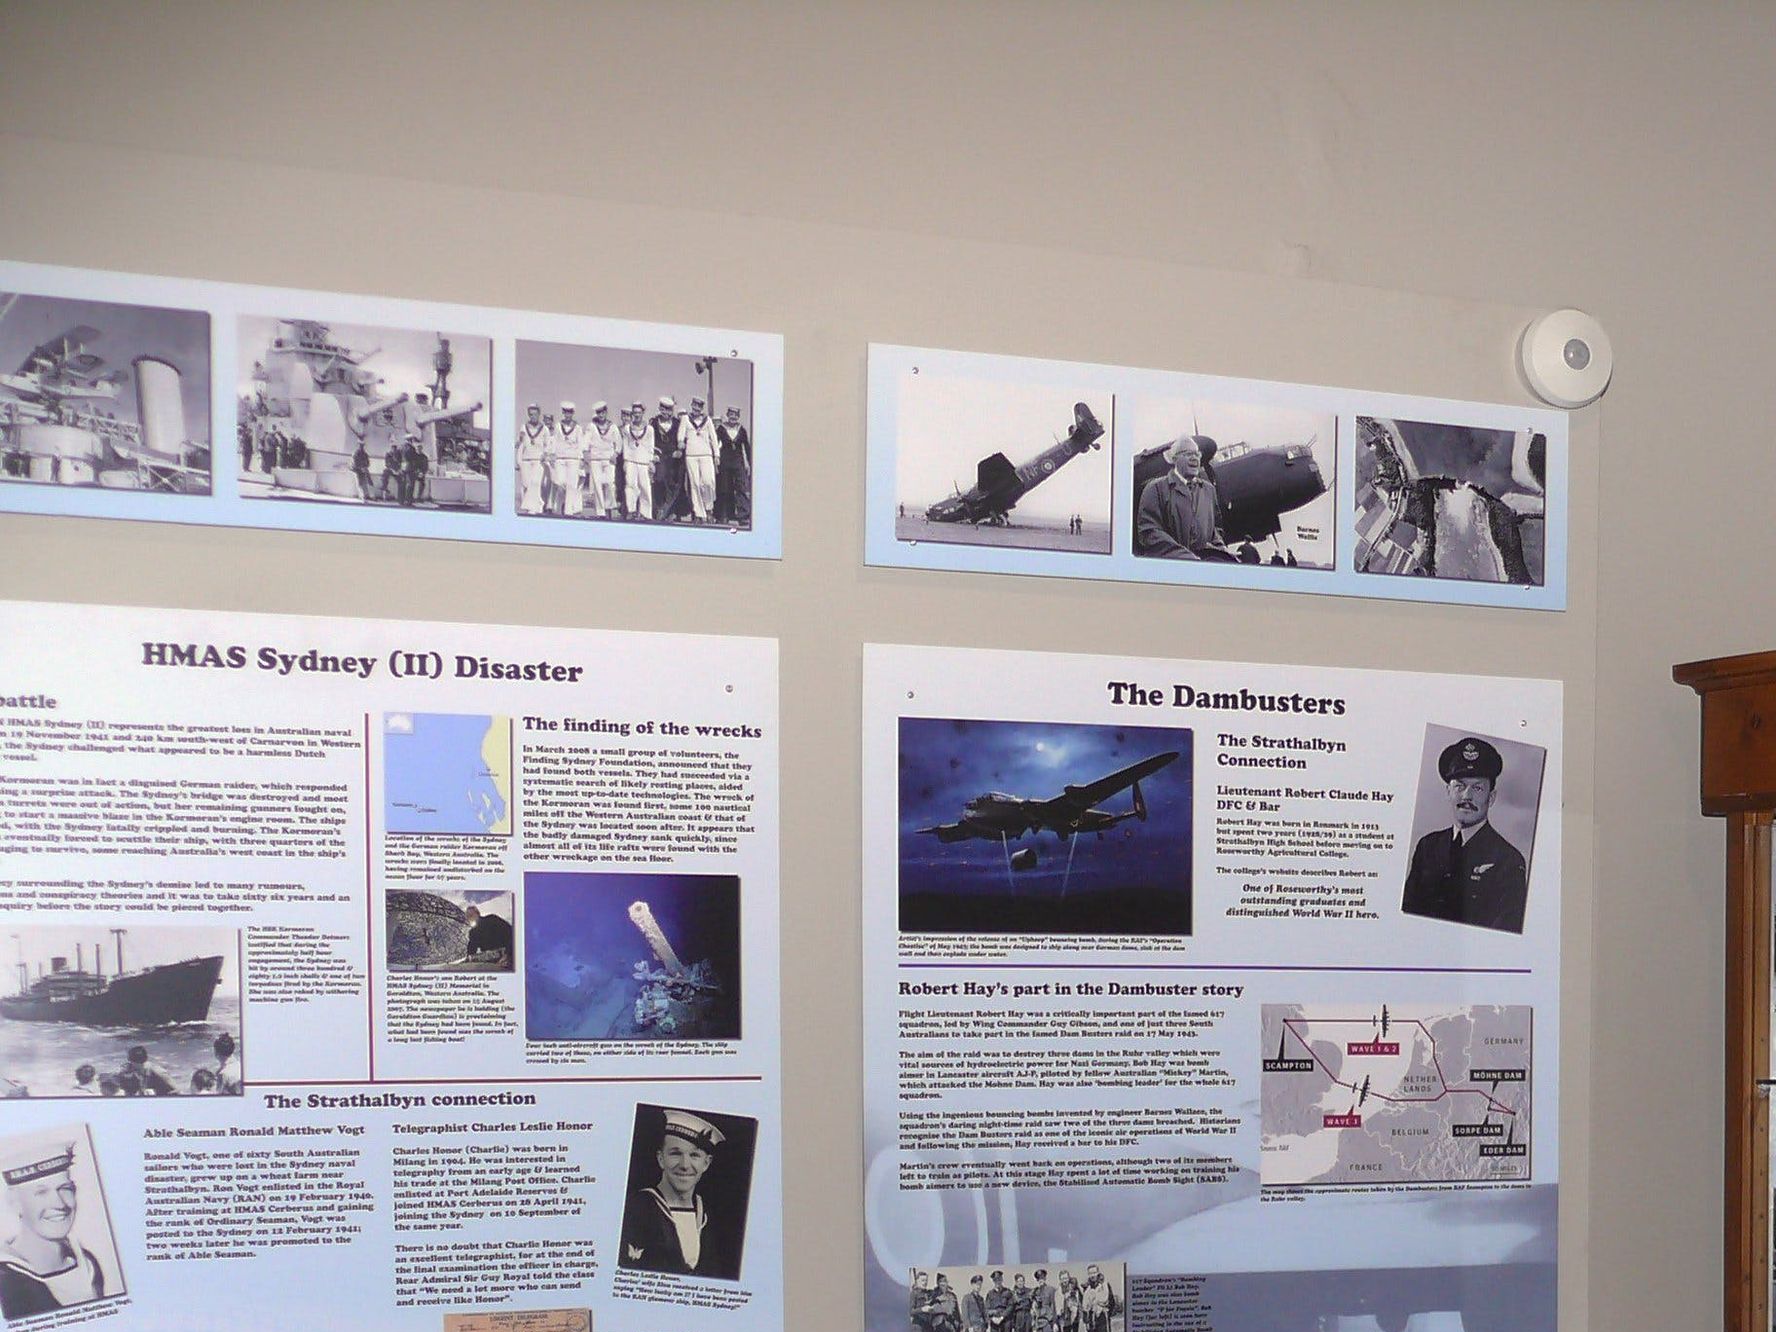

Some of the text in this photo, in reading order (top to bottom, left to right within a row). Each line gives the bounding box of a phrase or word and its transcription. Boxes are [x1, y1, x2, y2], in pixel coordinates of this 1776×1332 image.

[141, 642, 583, 682] HMAS Sydney (II) Disaster
[1107, 682, 1346, 716] The Dambusters
[523, 717, 762, 738] The finding of the wrecks
[1217, 734, 1346, 753] The Strathalbyn
[536, 745, 565, 754] March
[601, 748, 625, 756] small
[628, 750, 655, 758] group
[670, 750, 722, 759] volunteers,
[1217, 754, 1307, 769] Connection
[1217, 786, 1394, 803] Lieutenant Robert Claude Hay
[1217, 800, 1280, 812] DFC & Bar
[1243, 884, 1261, 892] One
[1264, 885, 1274, 894] of
[1276, 885, 1339, 895] Roseworthy's
[1240, 897, 1297, 907] outstanding
[1299, 898, 1346, 907] graduates
[1226, 908, 1379, 919] distinguished World War II hero.
[898, 982, 1244, 999] Robert Hay's part in the Dambuster story
[1484, 1038, 1524, 1046] GERMANY
[1351, 1045, 1374, 1053] WAVE
[1265, 1062, 1312, 1070] SCAMPTON
[264, 1092, 536, 1110] The Strathalbyn connection
[144, 1125, 365, 1138] Able Seaman Ronald Matthew Vogt
[393, 1122, 593, 1135] Telegraphist Charles Leslie Honor
[393, 1147, 430, 1155] Charles
[466, 1146, 509, 1155] (Charlie)
[559, 1144, 568, 1152] in
[1350, 1163, 1383, 1171] FRANCE
